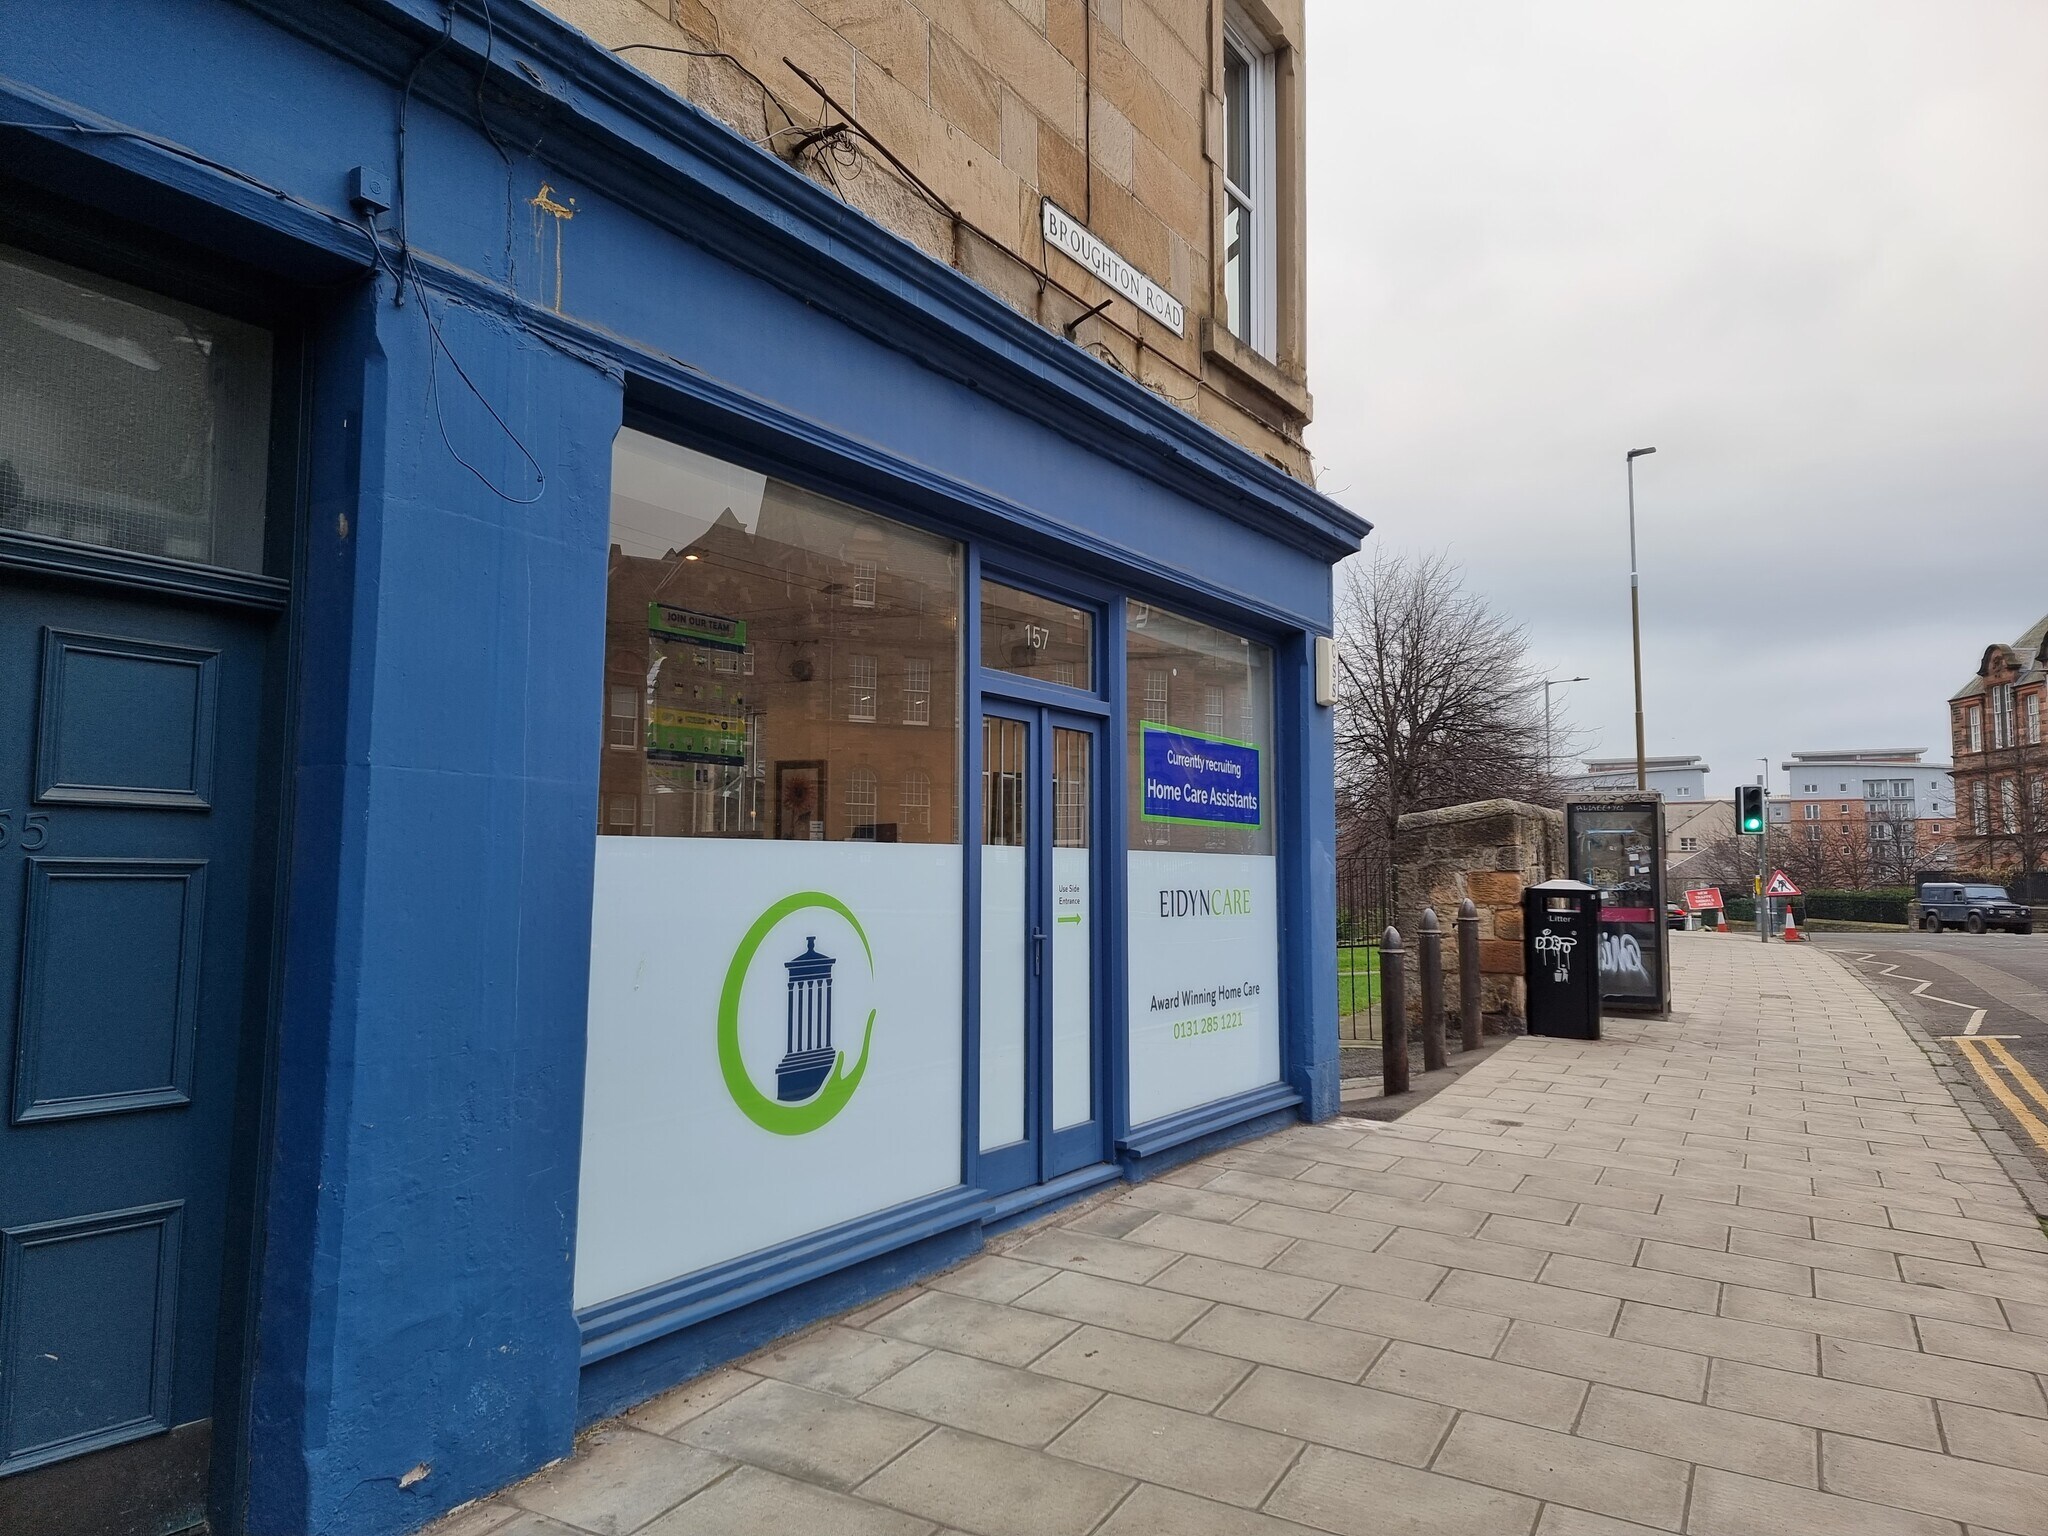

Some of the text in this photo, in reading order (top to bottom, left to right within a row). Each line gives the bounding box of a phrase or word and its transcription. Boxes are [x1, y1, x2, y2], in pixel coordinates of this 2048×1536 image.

[1049, 211, 1181, 327] BROUGHTON ROAD
[667, 611, 730, 632] JOIN OUR TEAM
[1025, 624, 1050, 650] 157
[1167, 750, 1241, 778] Currently recruiting
[1147, 778, 1258, 810] Home Care Assistants
[1059, 897, 1080, 905] Entrance
[1069, 884, 1080, 892] Side
[1549, 915, 1571, 923] Litter
[1150, 981, 1260, 1012] Award Winning Home Care
[1173, 1012, 1243, 1040] 0131 285 1221
